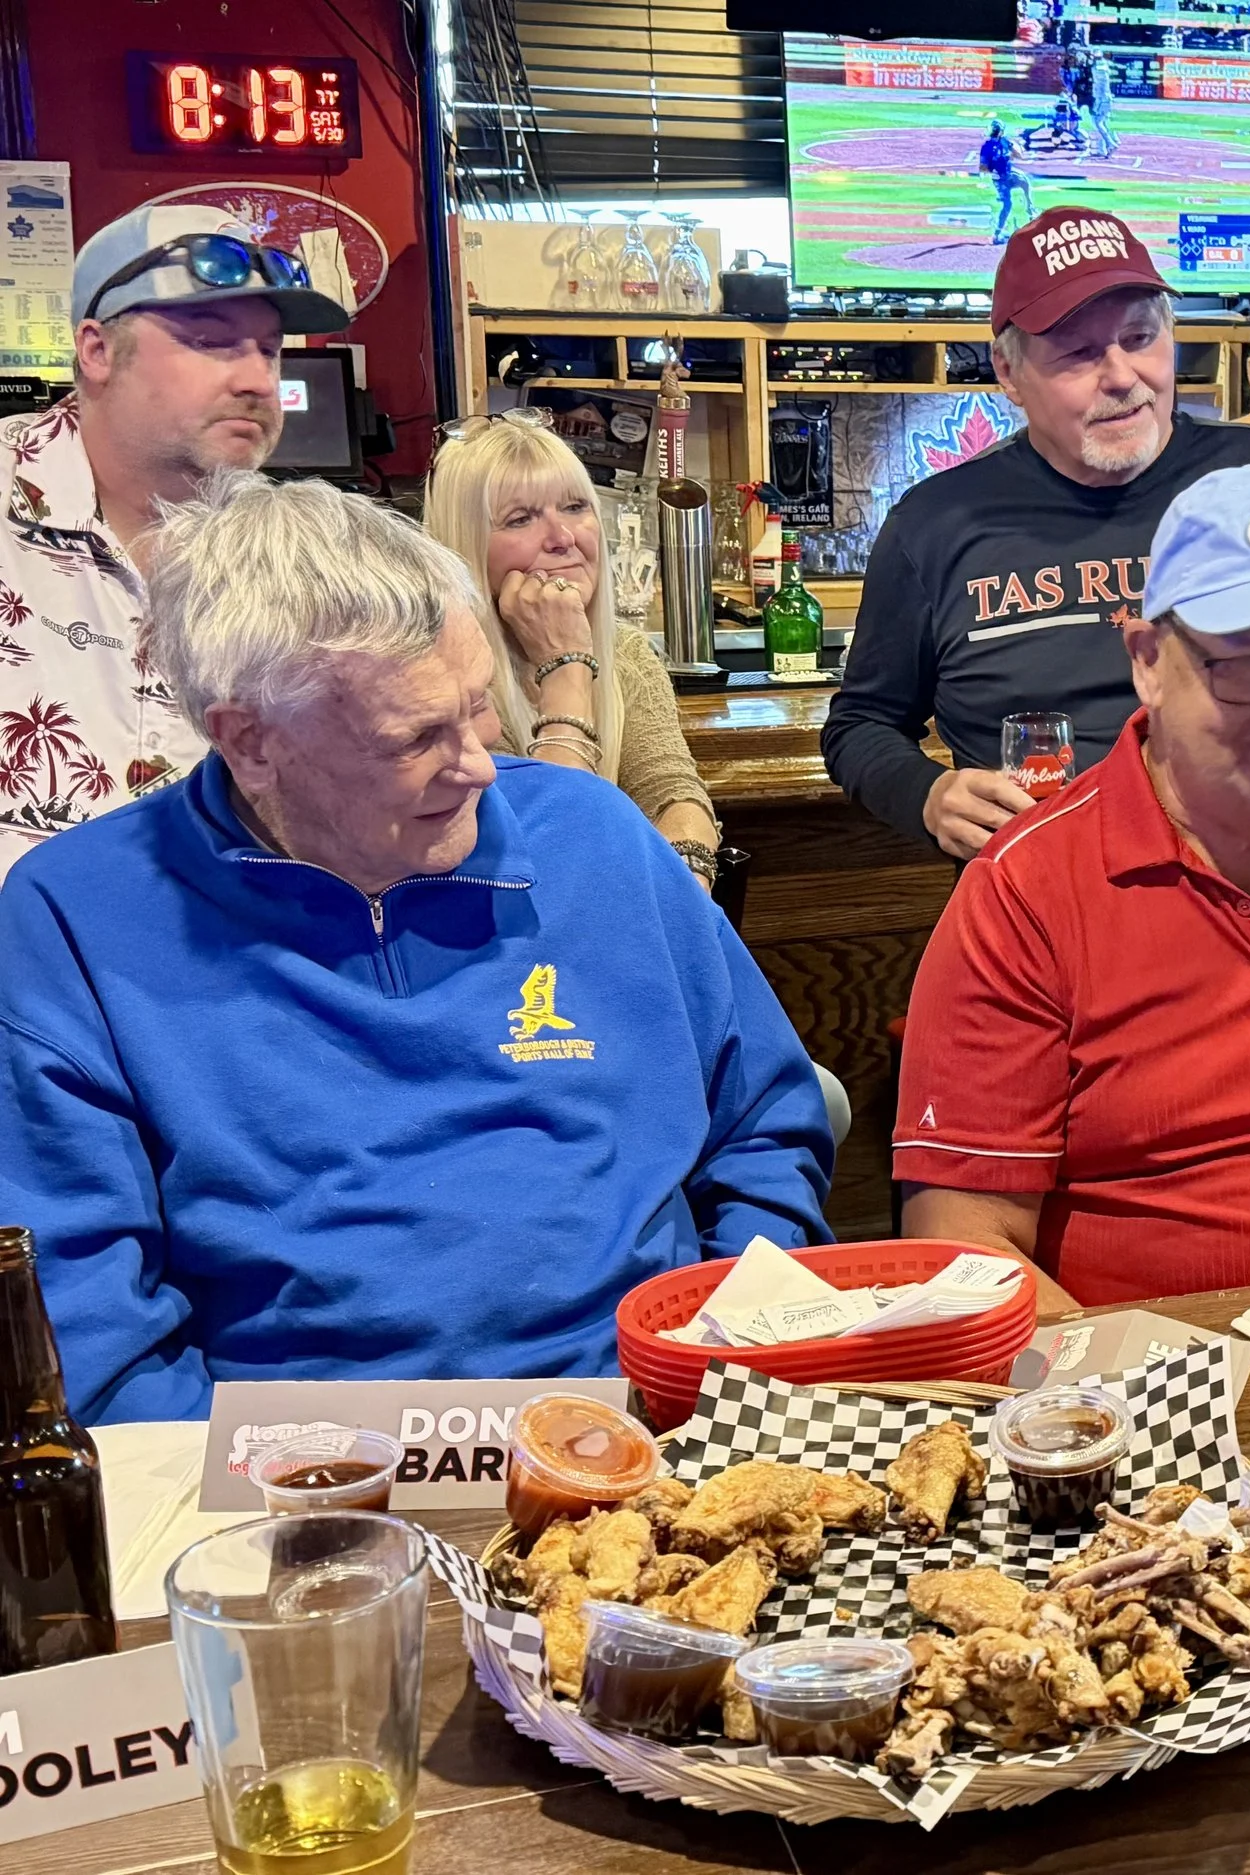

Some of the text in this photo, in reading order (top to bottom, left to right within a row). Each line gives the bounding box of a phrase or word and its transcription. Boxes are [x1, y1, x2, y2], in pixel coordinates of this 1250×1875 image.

[168, 65, 306, 143] 8:13
[310, 111, 340, 126] SAT
[1031, 219, 1125, 258] PAGANS
[1045, 238, 1129, 276] RUGBY
[0, 384, 32, 394] RVED
[779, 505, 806, 514] MES'S
[792, 514, 830, 522] IRELAND
[967, 565, 1065, 621] TAS
[1019, 766, 1067, 789] Molson
[400, 1406, 516, 1443] DON
[395, 1447, 512, 1484] BAR
